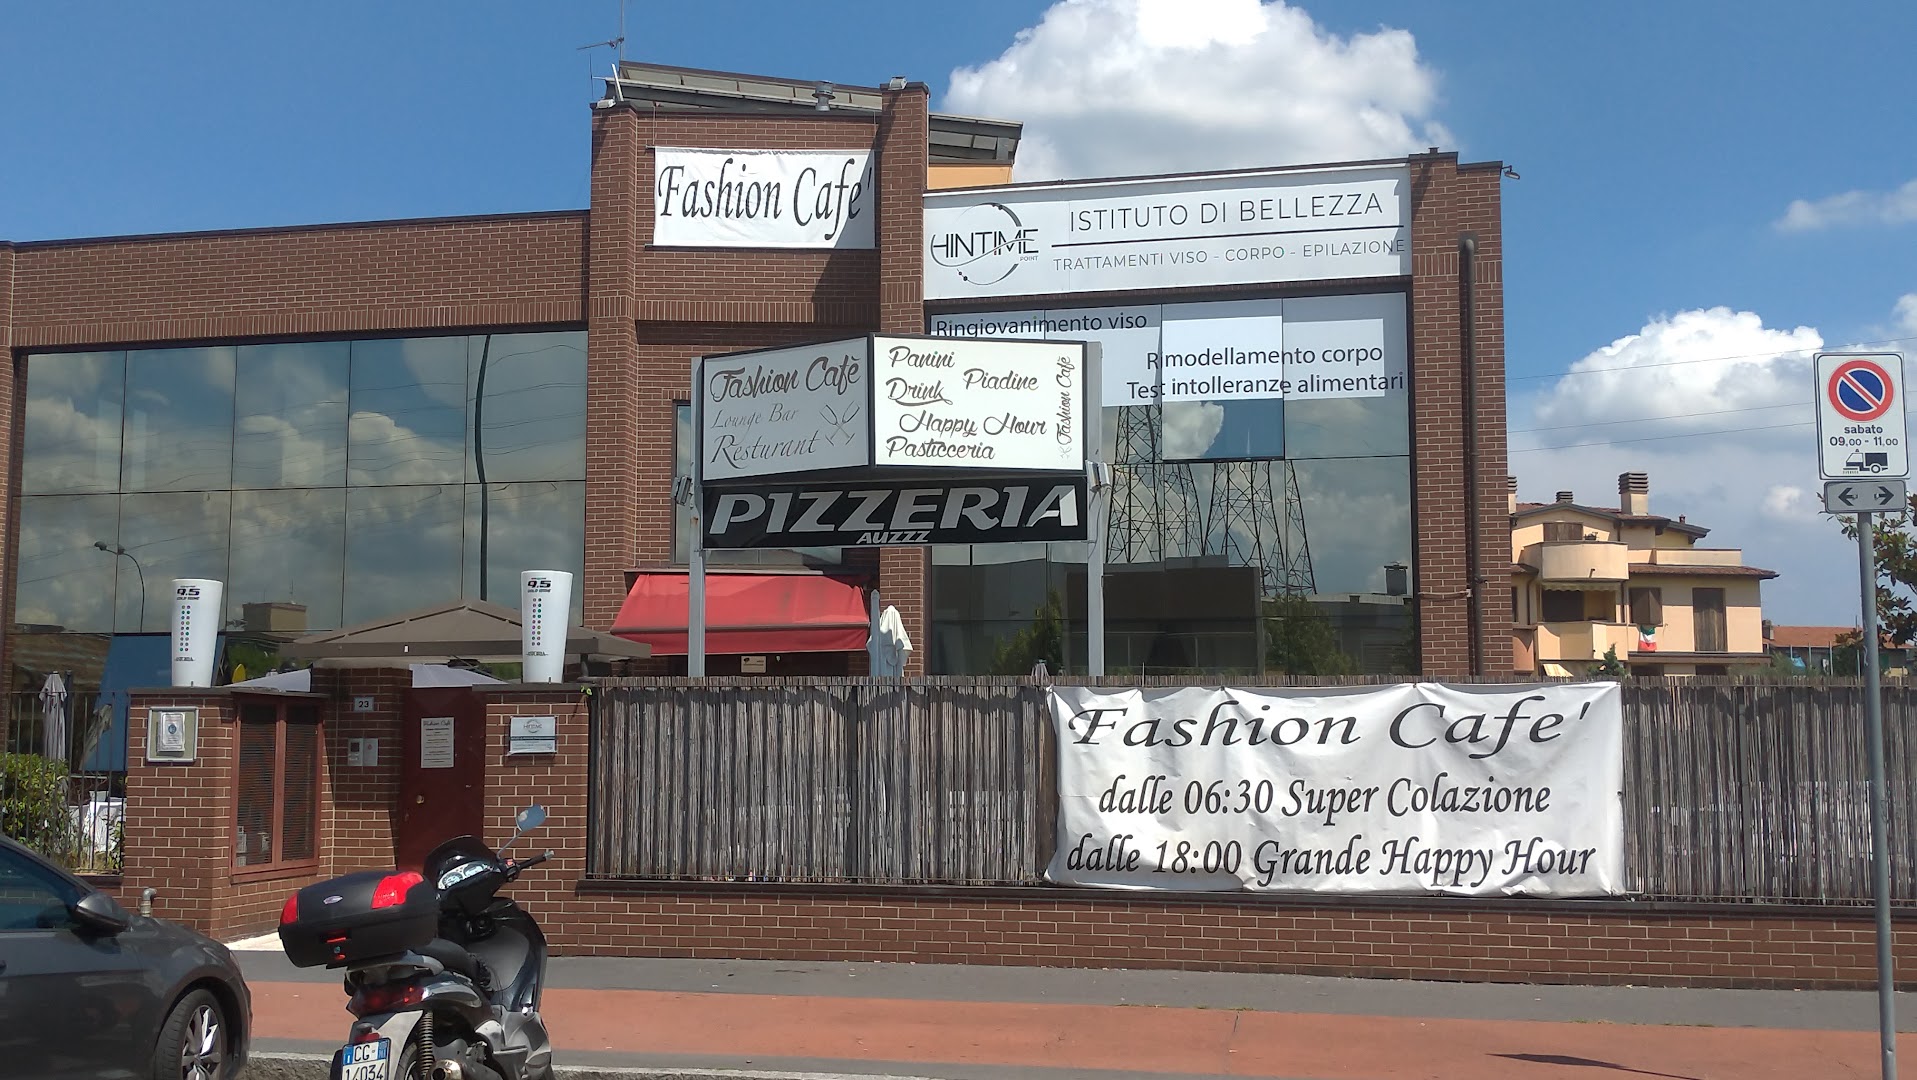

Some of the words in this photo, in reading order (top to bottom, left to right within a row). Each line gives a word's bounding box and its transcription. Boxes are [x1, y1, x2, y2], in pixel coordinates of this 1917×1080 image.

[657, 157, 783, 220] Fashion
[1069, 203, 1189, 233] ISTITUTO
[1199, 202, 1228, 225] DI
[1239, 192, 1384, 223] BELLEZZA
[1052, 252, 1165, 272] TRATTAMENTI
[1169, 250, 1209, 266] VISO
[1224, 245, 1286, 262] CORPO
[1302, 238, 1406, 258] EPILAZIONE
[935, 314, 1103, 338] Ringiovanimento
[1107, 312, 1148, 330] viso
[888, 345, 956, 369] Panini
[1146, 346, 1317, 371] Rimodellamento
[1321, 346, 1384, 369] corpo
[709, 364, 800, 403] Fashion
[885, 376, 954, 406] Drink
[962, 367, 1040, 392] Piadine
[1126, 381, 1166, 400] Test
[1170, 375, 1293, 396] intolleranze
[1296, 371, 1405, 394] alimentari
[710, 409, 763, 436] Lounge
[767, 402, 800, 424] Bar
[898, 409, 979, 438] Happy
[982, 411, 1049, 436] Hour
[1055, 390, 1073, 446] Fashion
[1843, 424, 1884, 435] sabato
[709, 430, 821, 470] Resturant
[885, 434, 996, 461] Pasticceria
[708, 485, 1079, 535] PIZZERIA
[855, 530, 931, 545] AUZZZ
[358, 700, 370, 708] 23
[1067, 699, 1361, 748] Fashion
[1098, 774, 1174, 816] dalle
[1183, 778, 1274, 816] 06:30
[1280, 778, 1380, 827] Super
[1387, 772, 1552, 816] Colazione
[1066, 832, 1140, 874] dalle
[1152, 838, 1243, 874] 18:00
[1253, 834, 1372, 887] Grande
[1379, 838, 1495, 887] Happy
[1500, 836, 1597, 876] Hour
[354, 1044, 371, 1062] CG
